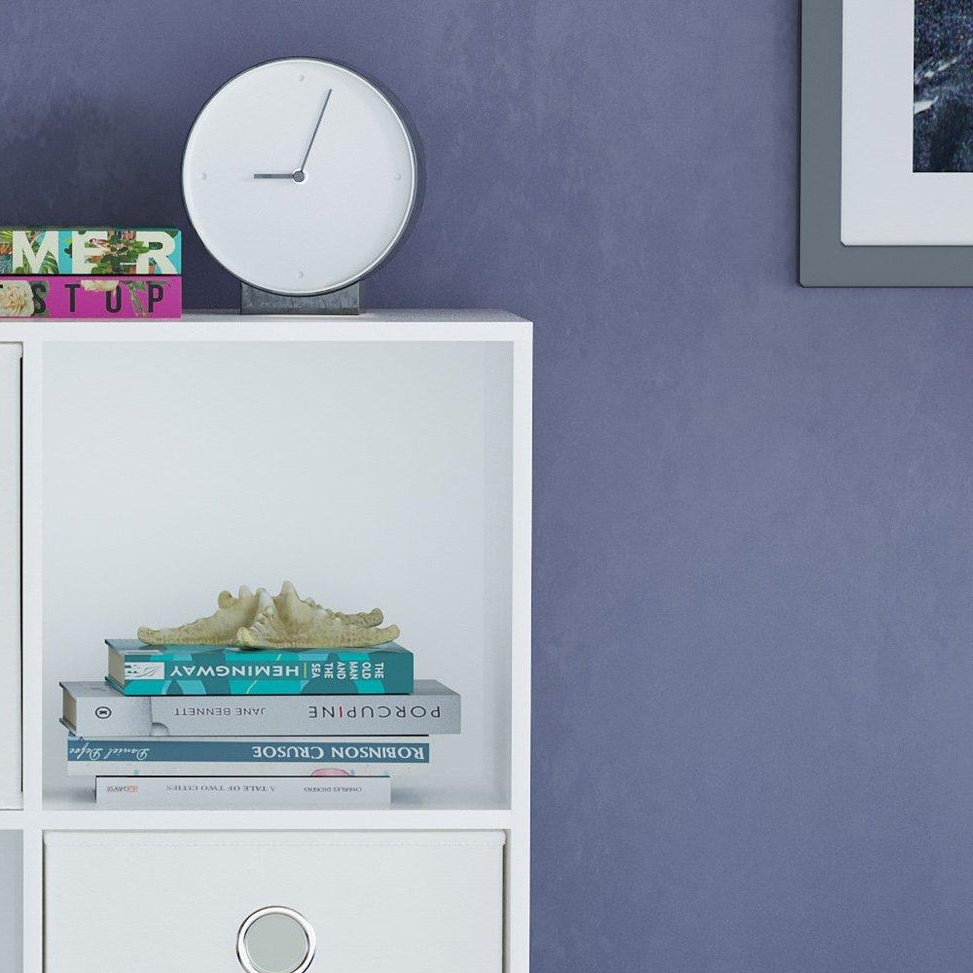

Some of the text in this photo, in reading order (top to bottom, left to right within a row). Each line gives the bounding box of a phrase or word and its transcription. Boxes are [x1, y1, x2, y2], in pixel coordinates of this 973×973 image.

[30, 279, 164, 313] STOP
[169, 664, 300, 679] HEMINGWAY
[311, 663, 321, 679] SEA
[324, 662, 333, 680] THE
[336, 661, 346, 680] AND
[349, 661, 359, 681] MAN
[362, 662, 372, 680] OLD
[375, 662, 385, 680] THE
[174, 706, 266, 717] JANE BENNETT
[308, 705, 441, 720] PORCUPINE
[69, 741, 150, 761] Daniel Defoe
[252, 745, 425, 760] ROBINSON CRUSOE
